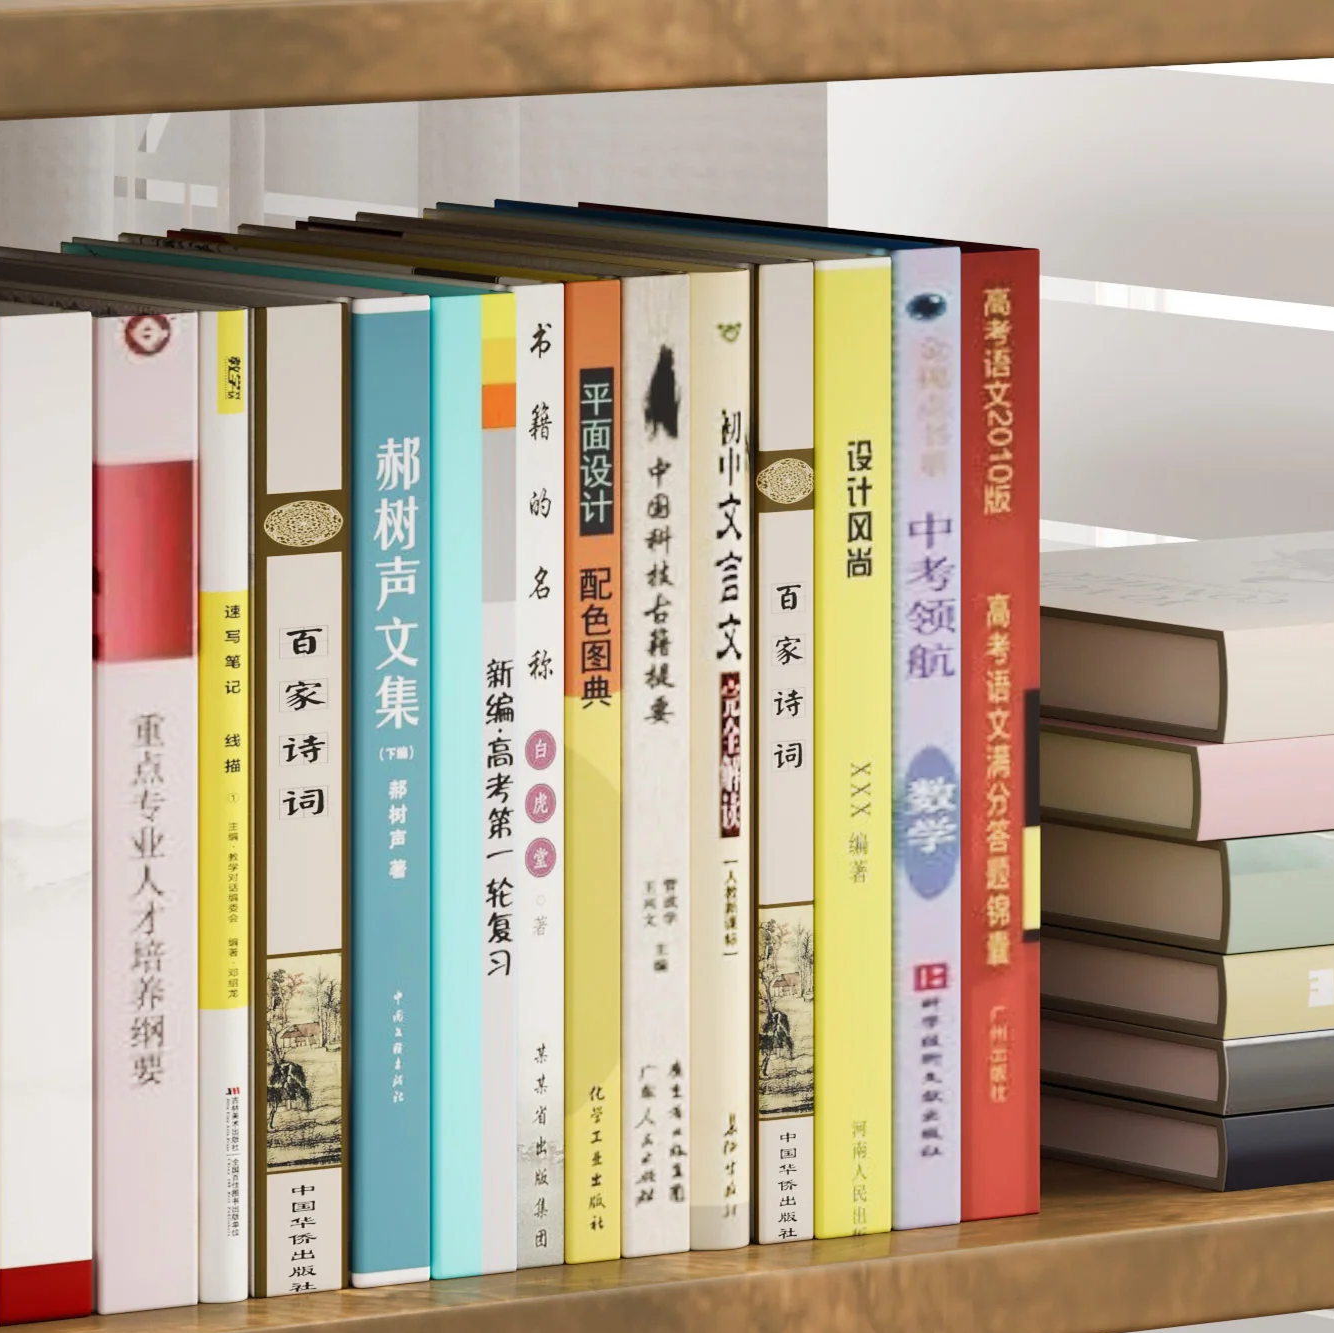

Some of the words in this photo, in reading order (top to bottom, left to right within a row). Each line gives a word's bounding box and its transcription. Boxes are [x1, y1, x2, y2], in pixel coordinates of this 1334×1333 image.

[579, 382, 613, 525] 平面设计
[983, 286, 1013, 515] 高考语文2010版
[528, 322, 554, 681] 书籍的名称
[716, 408, 743, 661] 初中文言文
[846, 440, 873, 579] 设计风尚
[224, 604, 242, 694] 速写笔记
[374, 435, 421, 730] 郝树声文集
[579, 566, 613, 709] 配色图典
[905, 511, 956, 680] 中考领航
[284, 628, 325, 817] 百家诗词
[775, 583, 803, 770] 百家诗词
[224, 733, 242, 774] 线描
[387, 779, 409, 850] 郝树声
[906, 778, 956, 852] 数学
[985, 594, 1012, 967] 高考语文满分答题锦囊
[130, 713, 166, 1086] 重点专业人才培养纲要
[388, 859, 408, 879] 著
[847, 831, 868, 884] 编著
[533, 1042, 549, 1249] 某某省出版集团
[588, 1084, 607, 1232] 化学工业出版社
[777, 1131, 799, 1240] 中国华侨出版社
[287, 1184, 318, 1293] 中国华侨出版社
